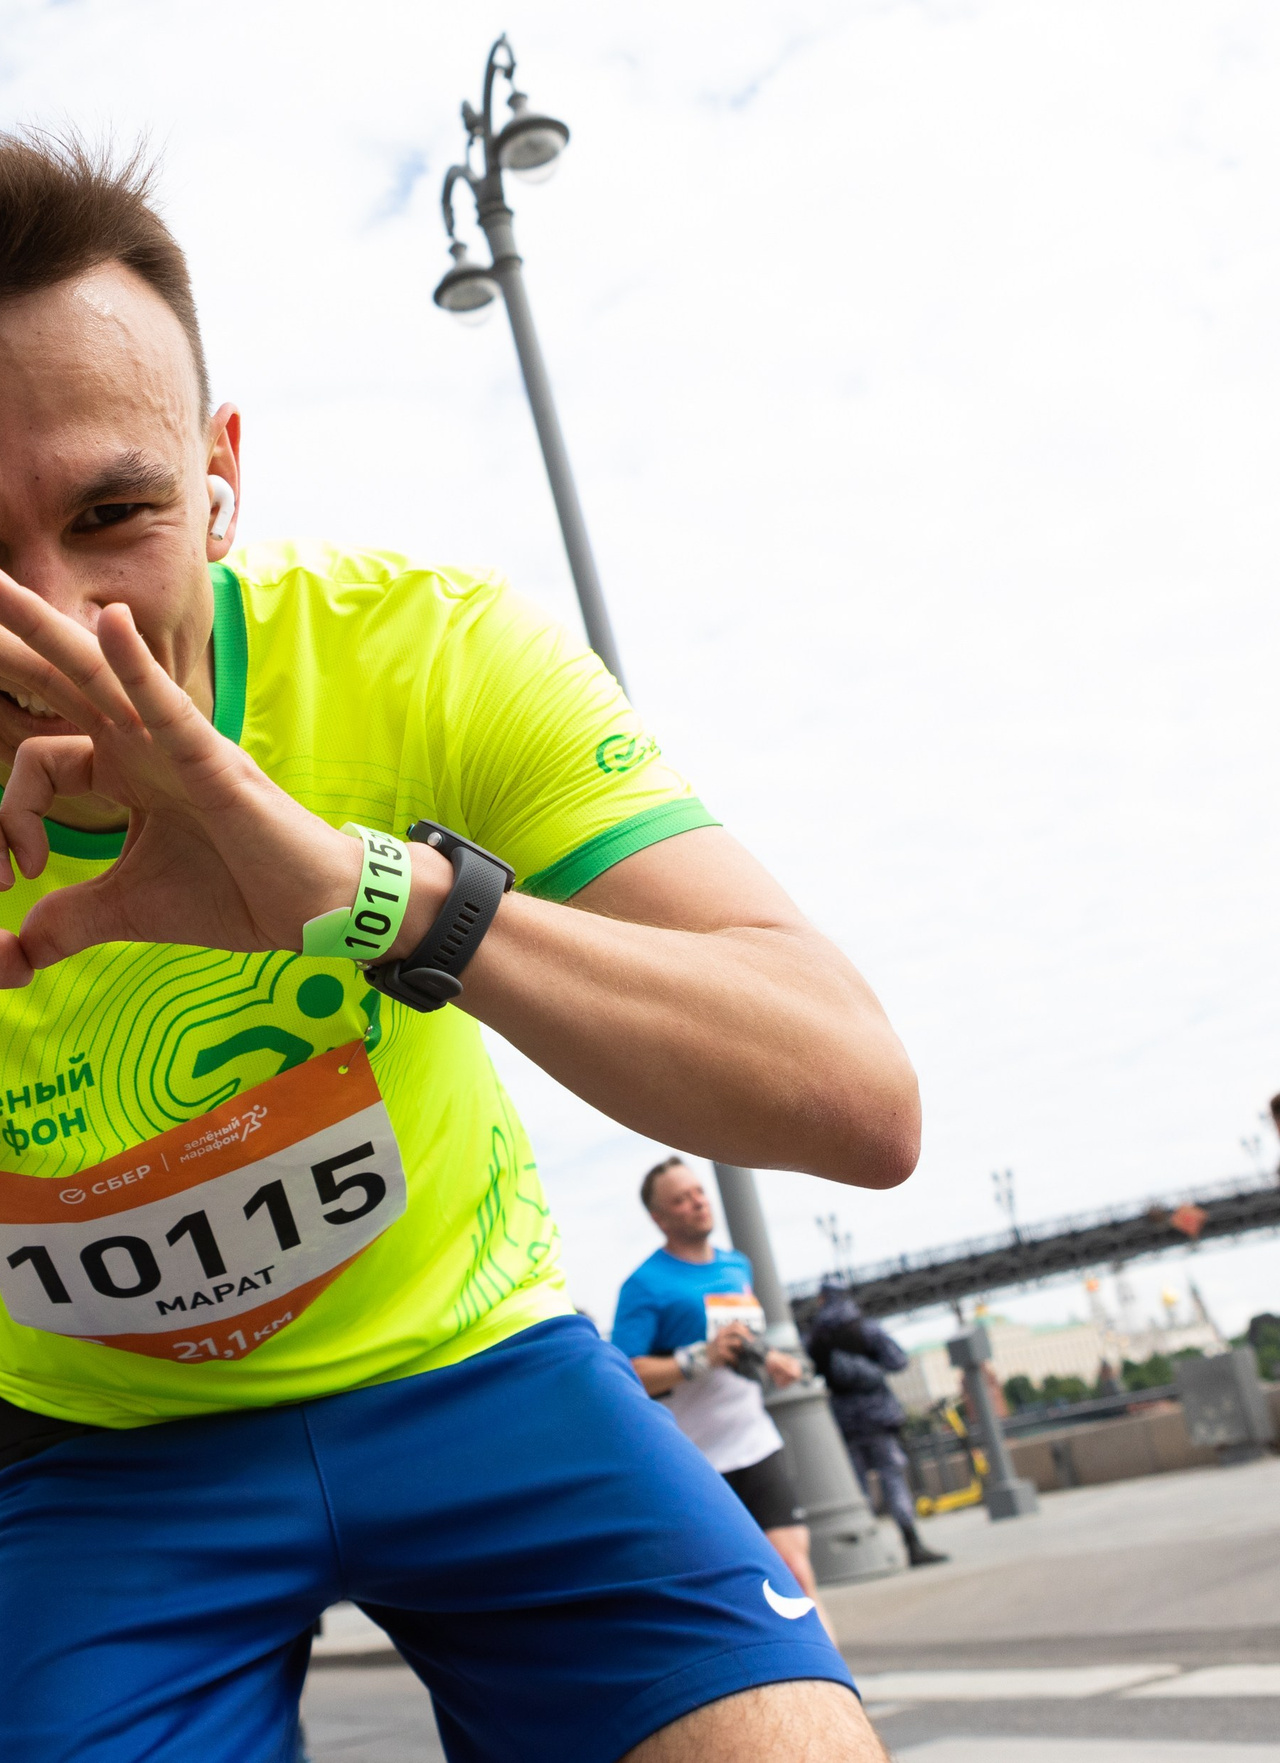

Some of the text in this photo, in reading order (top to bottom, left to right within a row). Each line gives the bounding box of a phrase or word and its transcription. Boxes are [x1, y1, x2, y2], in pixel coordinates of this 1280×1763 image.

[345, 839, 403, 950] 10115
[180, 1131, 239, 1164] марафон
[184, 1117, 241, 1151] зелёный
[91, 1163, 151, 1195] СБЕР
[6, 1140, 387, 1304] 10115
[155, 1265, 275, 1316] МАРАТ
[172, 1329, 248, 1360] 21,1
